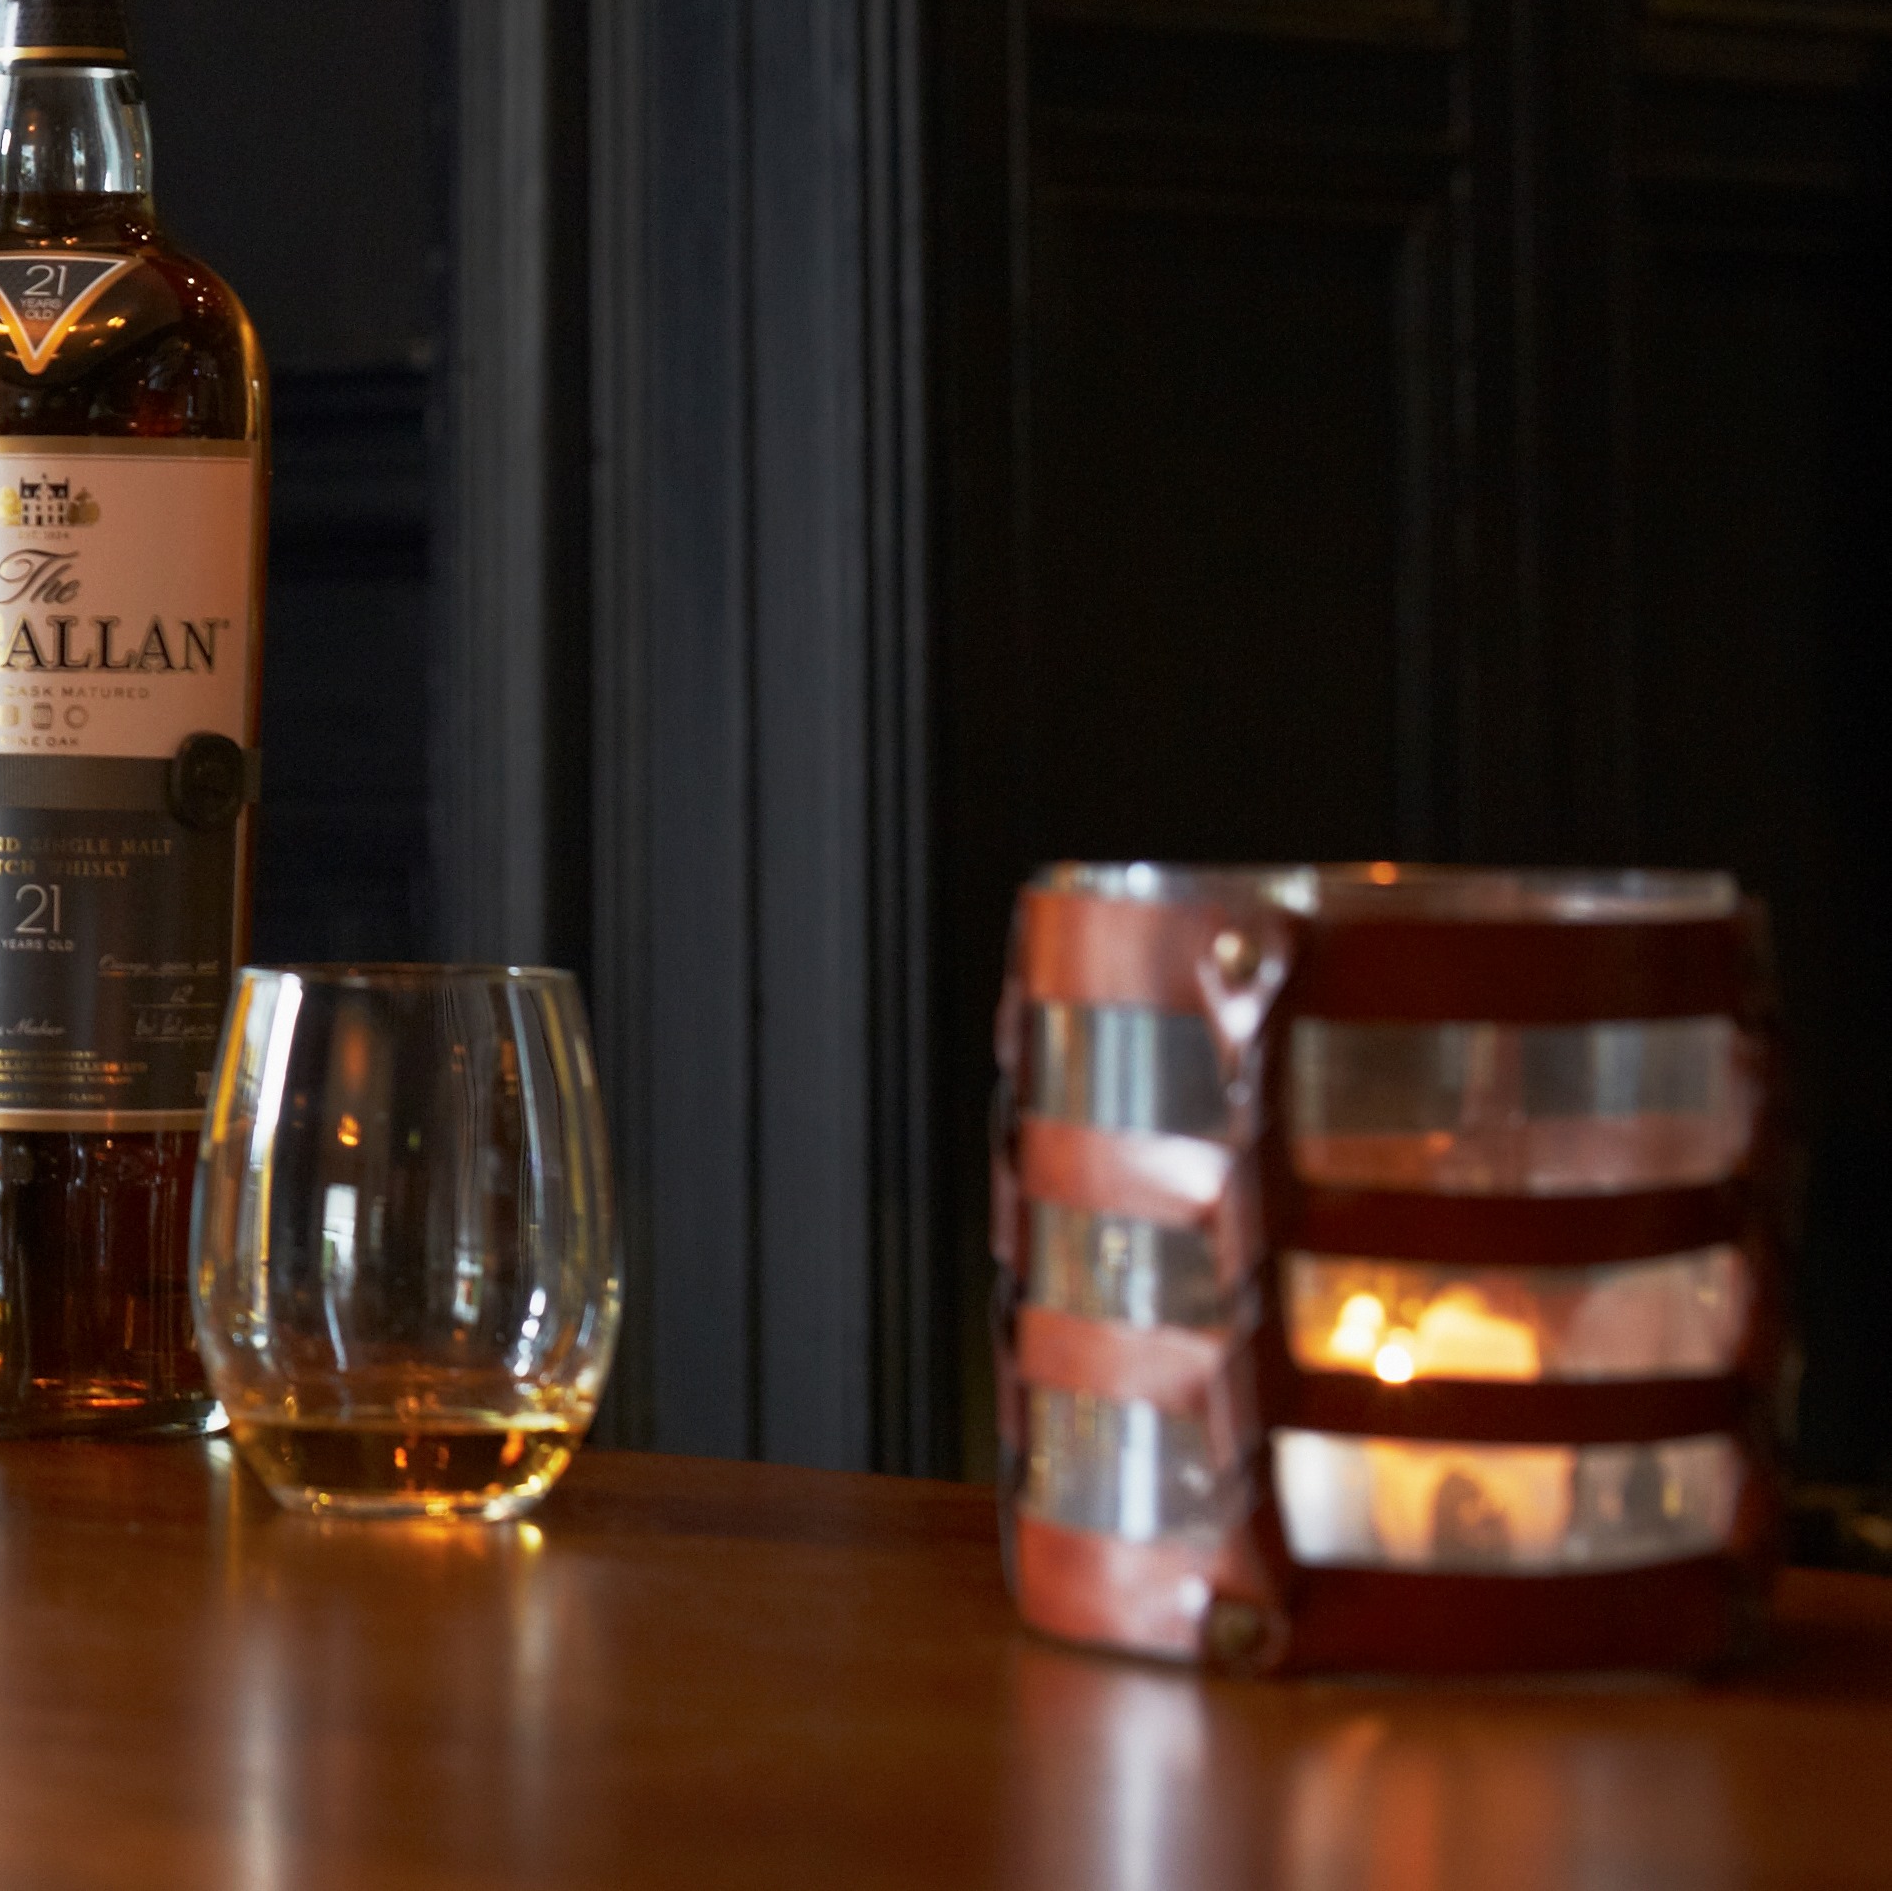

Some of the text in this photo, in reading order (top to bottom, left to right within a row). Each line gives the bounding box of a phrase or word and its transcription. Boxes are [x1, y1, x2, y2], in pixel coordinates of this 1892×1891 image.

[23, 264, 67, 296] 21
[19, 297, 62, 309] YEARS
[24, 309, 54, 320] OLD
[5, 685, 52, 698] CASK
[61, 686, 150, 699] MATURED
[46, 736, 80, 747] OAK
[15, 883, 61, 934] 21
[1, 938, 74, 952] YEARS OLD
